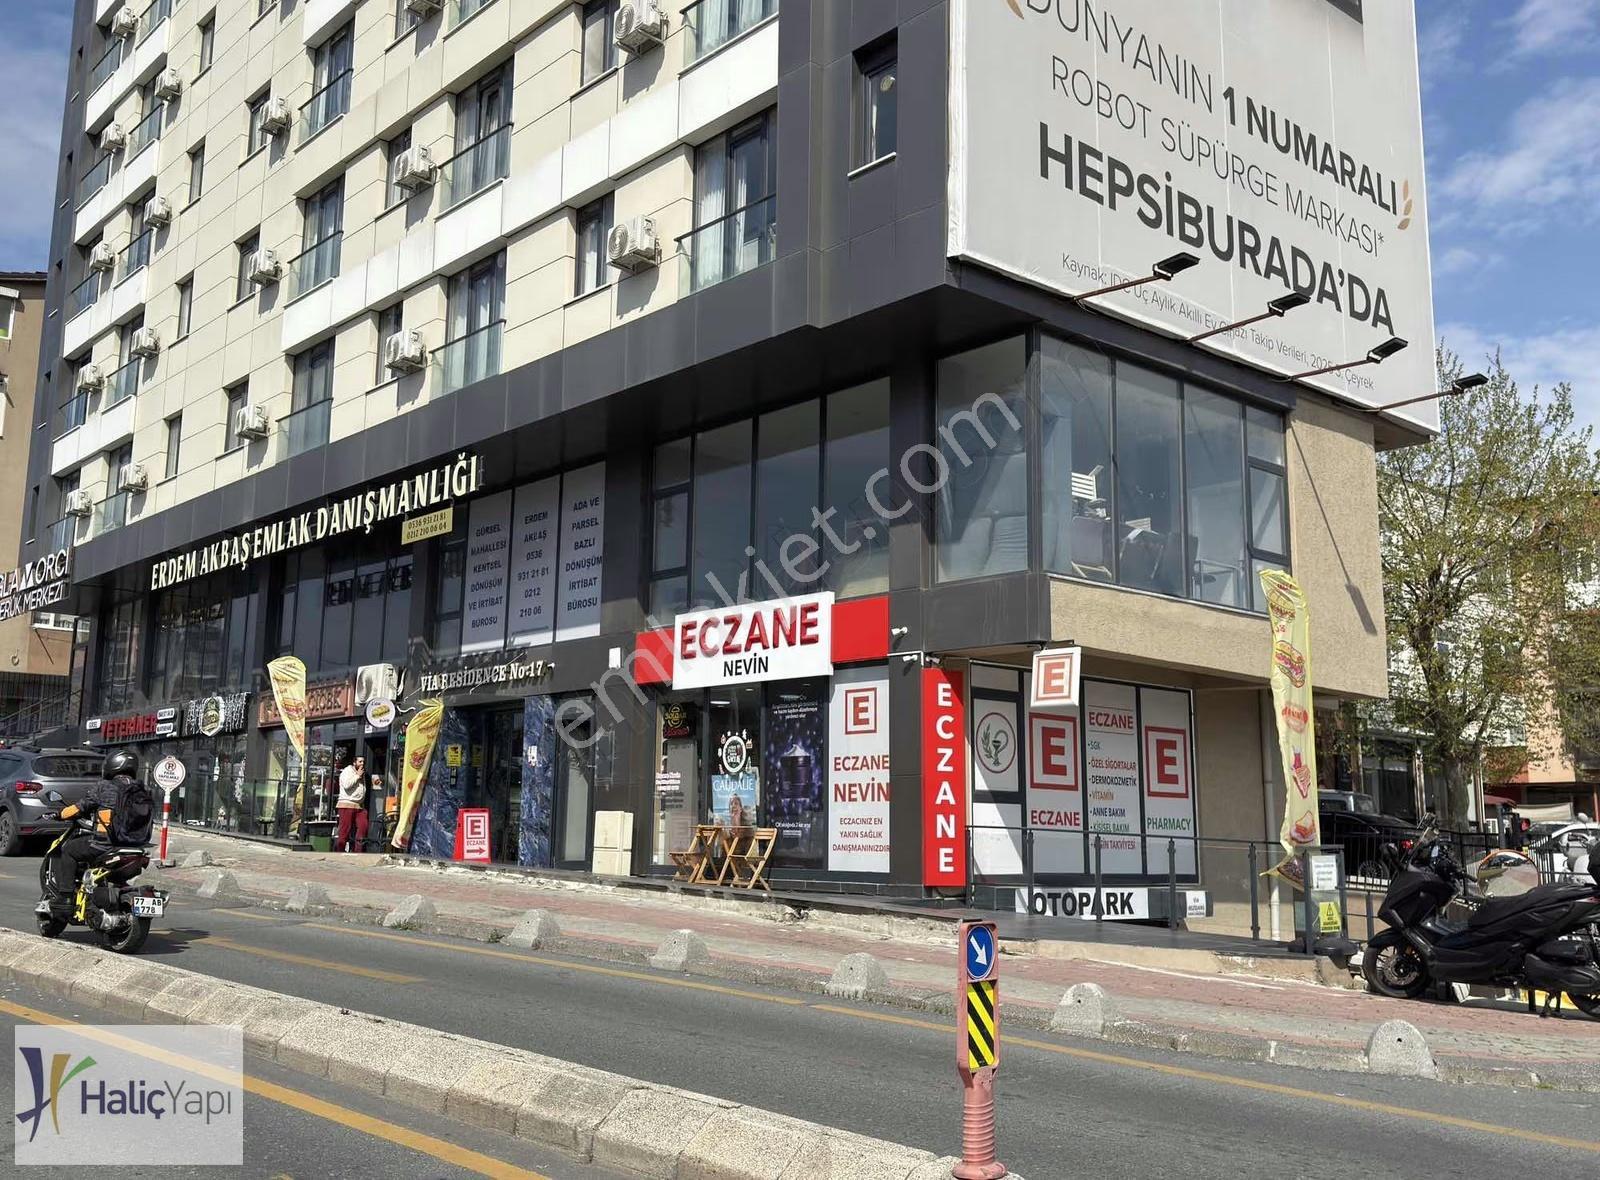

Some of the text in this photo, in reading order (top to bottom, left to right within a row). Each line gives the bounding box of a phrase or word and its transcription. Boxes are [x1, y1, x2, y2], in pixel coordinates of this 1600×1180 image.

[1052, 55, 1152, 138] ROBOT
[1161, 117, 1278, 206] SÜPÜRGE
[1223, 86, 1236, 126] 1
[1246, 96, 1397, 216] NUMARALI
[1039, 121, 1396, 337] HEPSİBURADA'DA
[1062, 252, 1107, 286] Kaynak:
[1151, 290, 1176, 316] Aylık
[1178, 302, 1201, 325] Akıllı
[1204, 313, 1217, 330] Ev
[1250, 328, 1274, 352] Takip
[1276, 339, 1309, 367] Verileri,
[1344, 367, 1375, 391] Çeyrek
[573, 496, 600, 512] ADA VE
[151, 452, 478, 591] ERDEM AKBAŞ EMLAK DANIŞMANLIĞI
[524, 511, 548, 525] ERDEM
[571, 517, 600, 531] PARSEL
[524, 529, 548, 543] AKBAŞ
[573, 537, 596, 551] BAZLI
[526, 549, 543, 561] 0536
[565, 555, 603, 572] DÖNÜŞÜM
[530, 568, 539, 579] 21
[568, 577, 598, 591] İRTİBAT
[524, 587, 541, 599] 0212
[468, 600, 477, 611] VE
[519, 605, 542, 618] 210 06
[567, 597, 598, 611] BÜROSU
[680, 602, 819, 660] ECZANE
[723, 652, 769, 678] NEVİN
[442, 666, 507, 689] RESİDENCE
[509, 659, 544, 680] No:17
[1043, 662, 1066, 695] E
[853, 696, 870, 726] E
[1088, 711, 1134, 730] ECZANE
[1041, 726, 1067, 776] E
[1090, 741, 1101, 751] SGK
[834, 754, 890, 772] ECZANE
[1091, 756, 1106, 769] ÖZEL
[1156, 738, 1179, 785] E
[935, 683, 956, 873] ECZANE
[1091, 774, 1137, 787] DERMOKOZMETİK
[834, 777, 891, 803] NEVİN
[1092, 790, 1114, 801] VİTAMİN
[1031, 810, 1081, 827] ECZANE
[1093, 807, 1126, 818] ANNE BAKIM
[470, 819, 481, 836] E
[839, 817, 883, 826] ECZACINIZ EN
[1146, 817, 1191, 831] PHARMACY
[839, 829, 883, 840] YAKIN SAĞLIK
[135, 897, 145, 906] 77
[1034, 891, 1135, 917] OTOPARK
